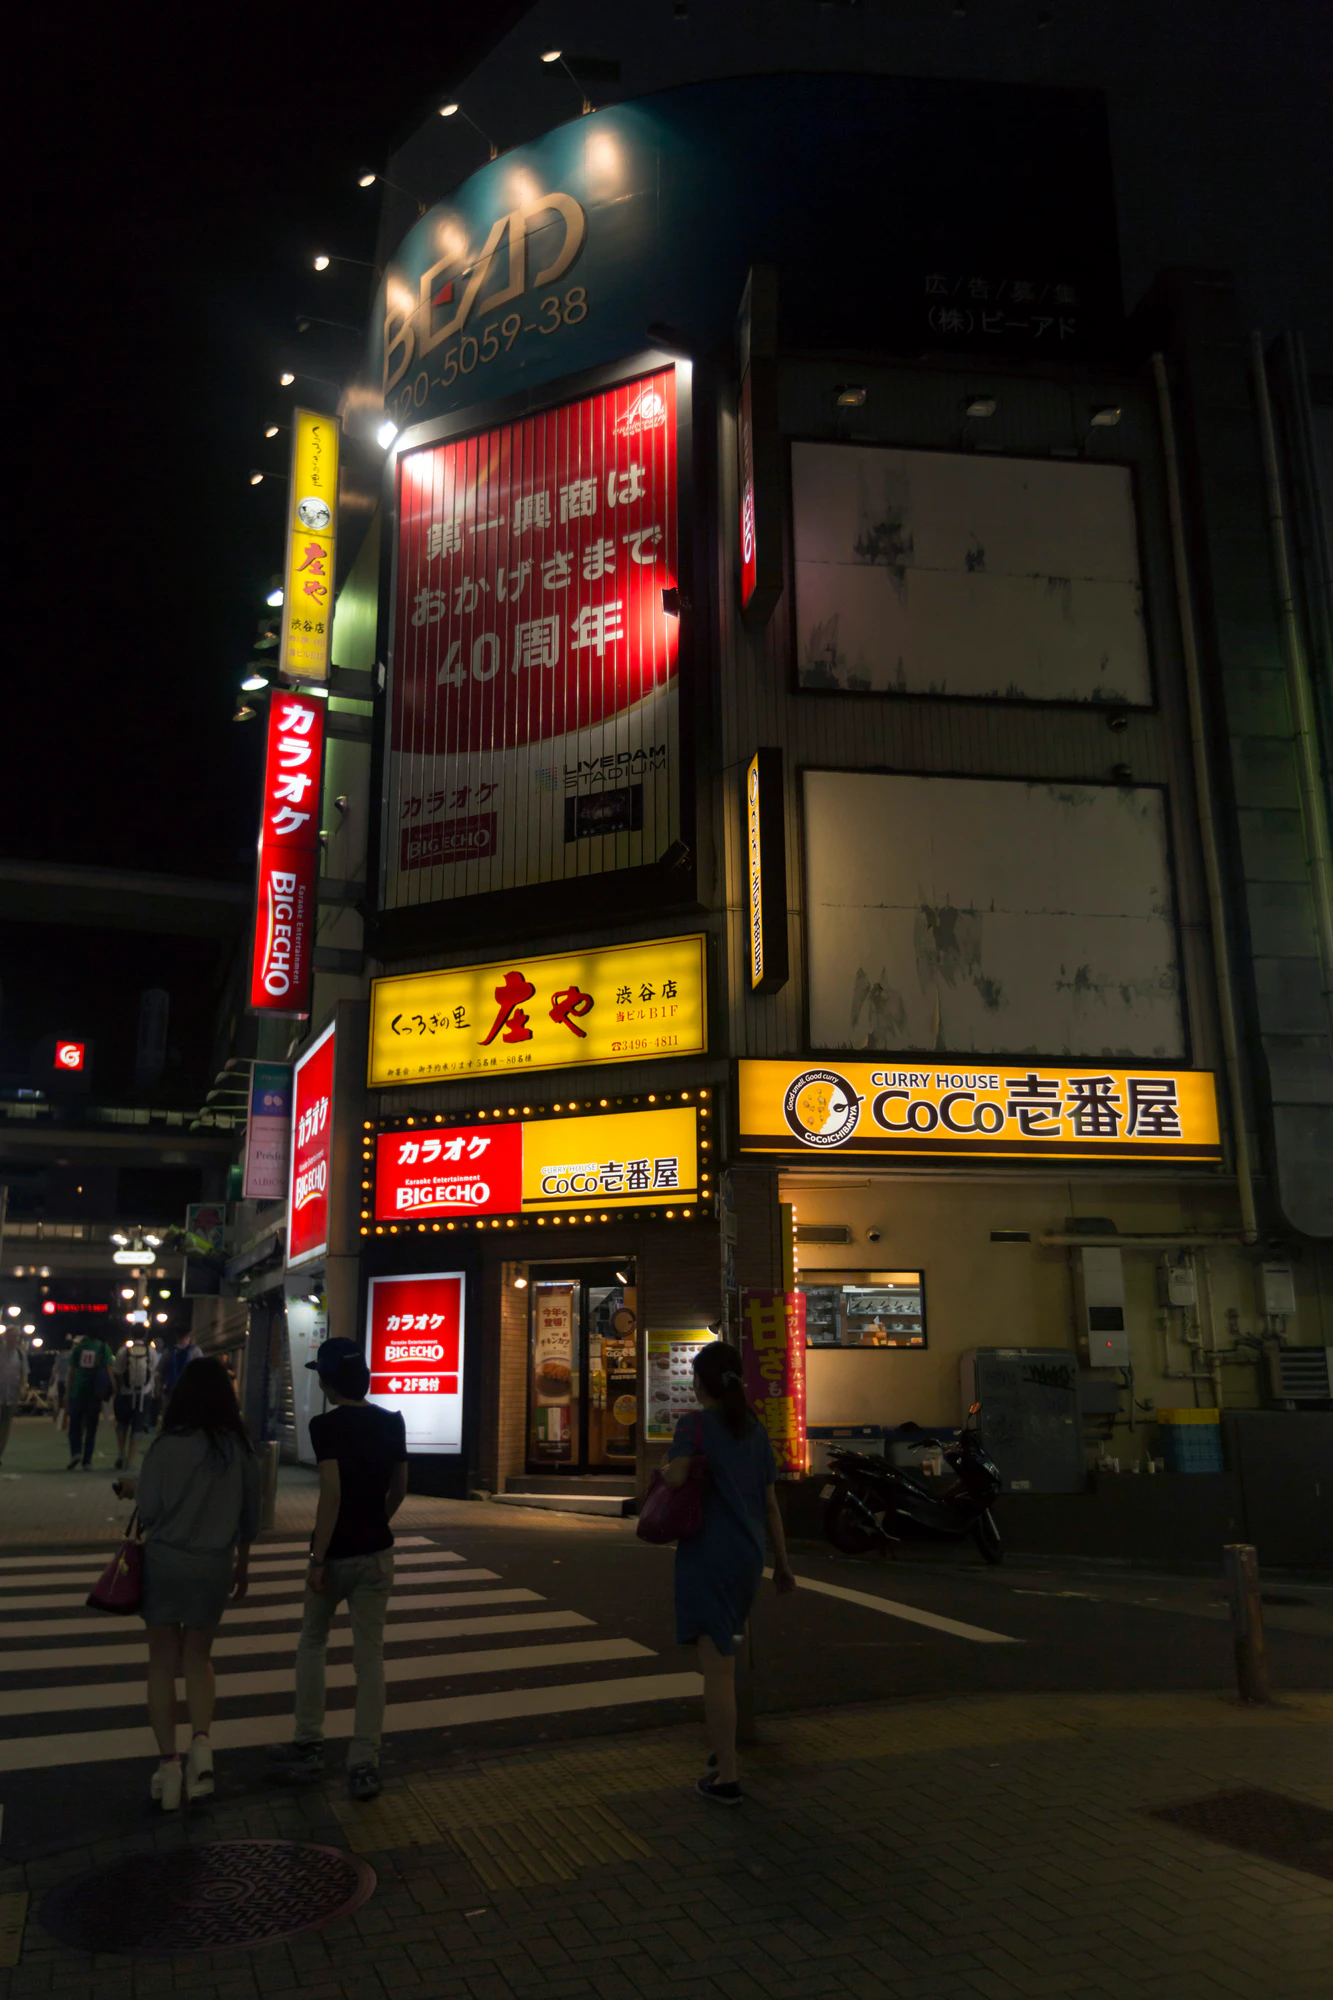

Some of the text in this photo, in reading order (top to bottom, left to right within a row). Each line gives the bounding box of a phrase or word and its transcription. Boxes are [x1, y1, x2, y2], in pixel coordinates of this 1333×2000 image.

[426, 464, 647, 561] 第一興商は
[296, 543, 328, 605] 庄や
[410, 525, 663, 627] おかげさまで
[291, 618, 324, 634] 渋谷店
[437, 601, 624, 688] 40周年
[271, 704, 316, 836] カラオケ
[564, 758, 666, 788] STADIUM
[401, 782, 498, 819] カラオケ
[407, 839, 439, 860] BIG
[444, 829, 490, 849] ECHO
[265, 871, 297, 995] BIG ECHO
[293, 885, 306, 984] Karaoke Entertainment
[616, 979, 678, 1005] 渋谷店
[391, 1006, 471, 1036] くつろぎの里
[477, 971, 594, 1045] 庄や
[616, 1004, 679, 1023] 当ビルB1F
[622, 1035, 679, 1051] 3496-4811
[871, 1072, 999, 1089] CURRY HOUSE
[872, 1074, 1184, 1138] CoCo壱番屋
[298, 1096, 328, 1149] カラオケ
[397, 1136, 491, 1165] カラオケ
[308, 1160, 326, 1193] ECHO
[405, 1174, 481, 1186] Karaoke Entertainment
[541, 1162, 597, 1174] CURRY HOUSE
[541, 1157, 679, 1195] CoCo壱番屋
[396, 1182, 490, 1209] BIG ECHO
[386, 1314, 445, 1331] カラオケ
[385, 1345, 444, 1361] BIG ECHO
[403, 1377, 440, 1392] 2F受付
